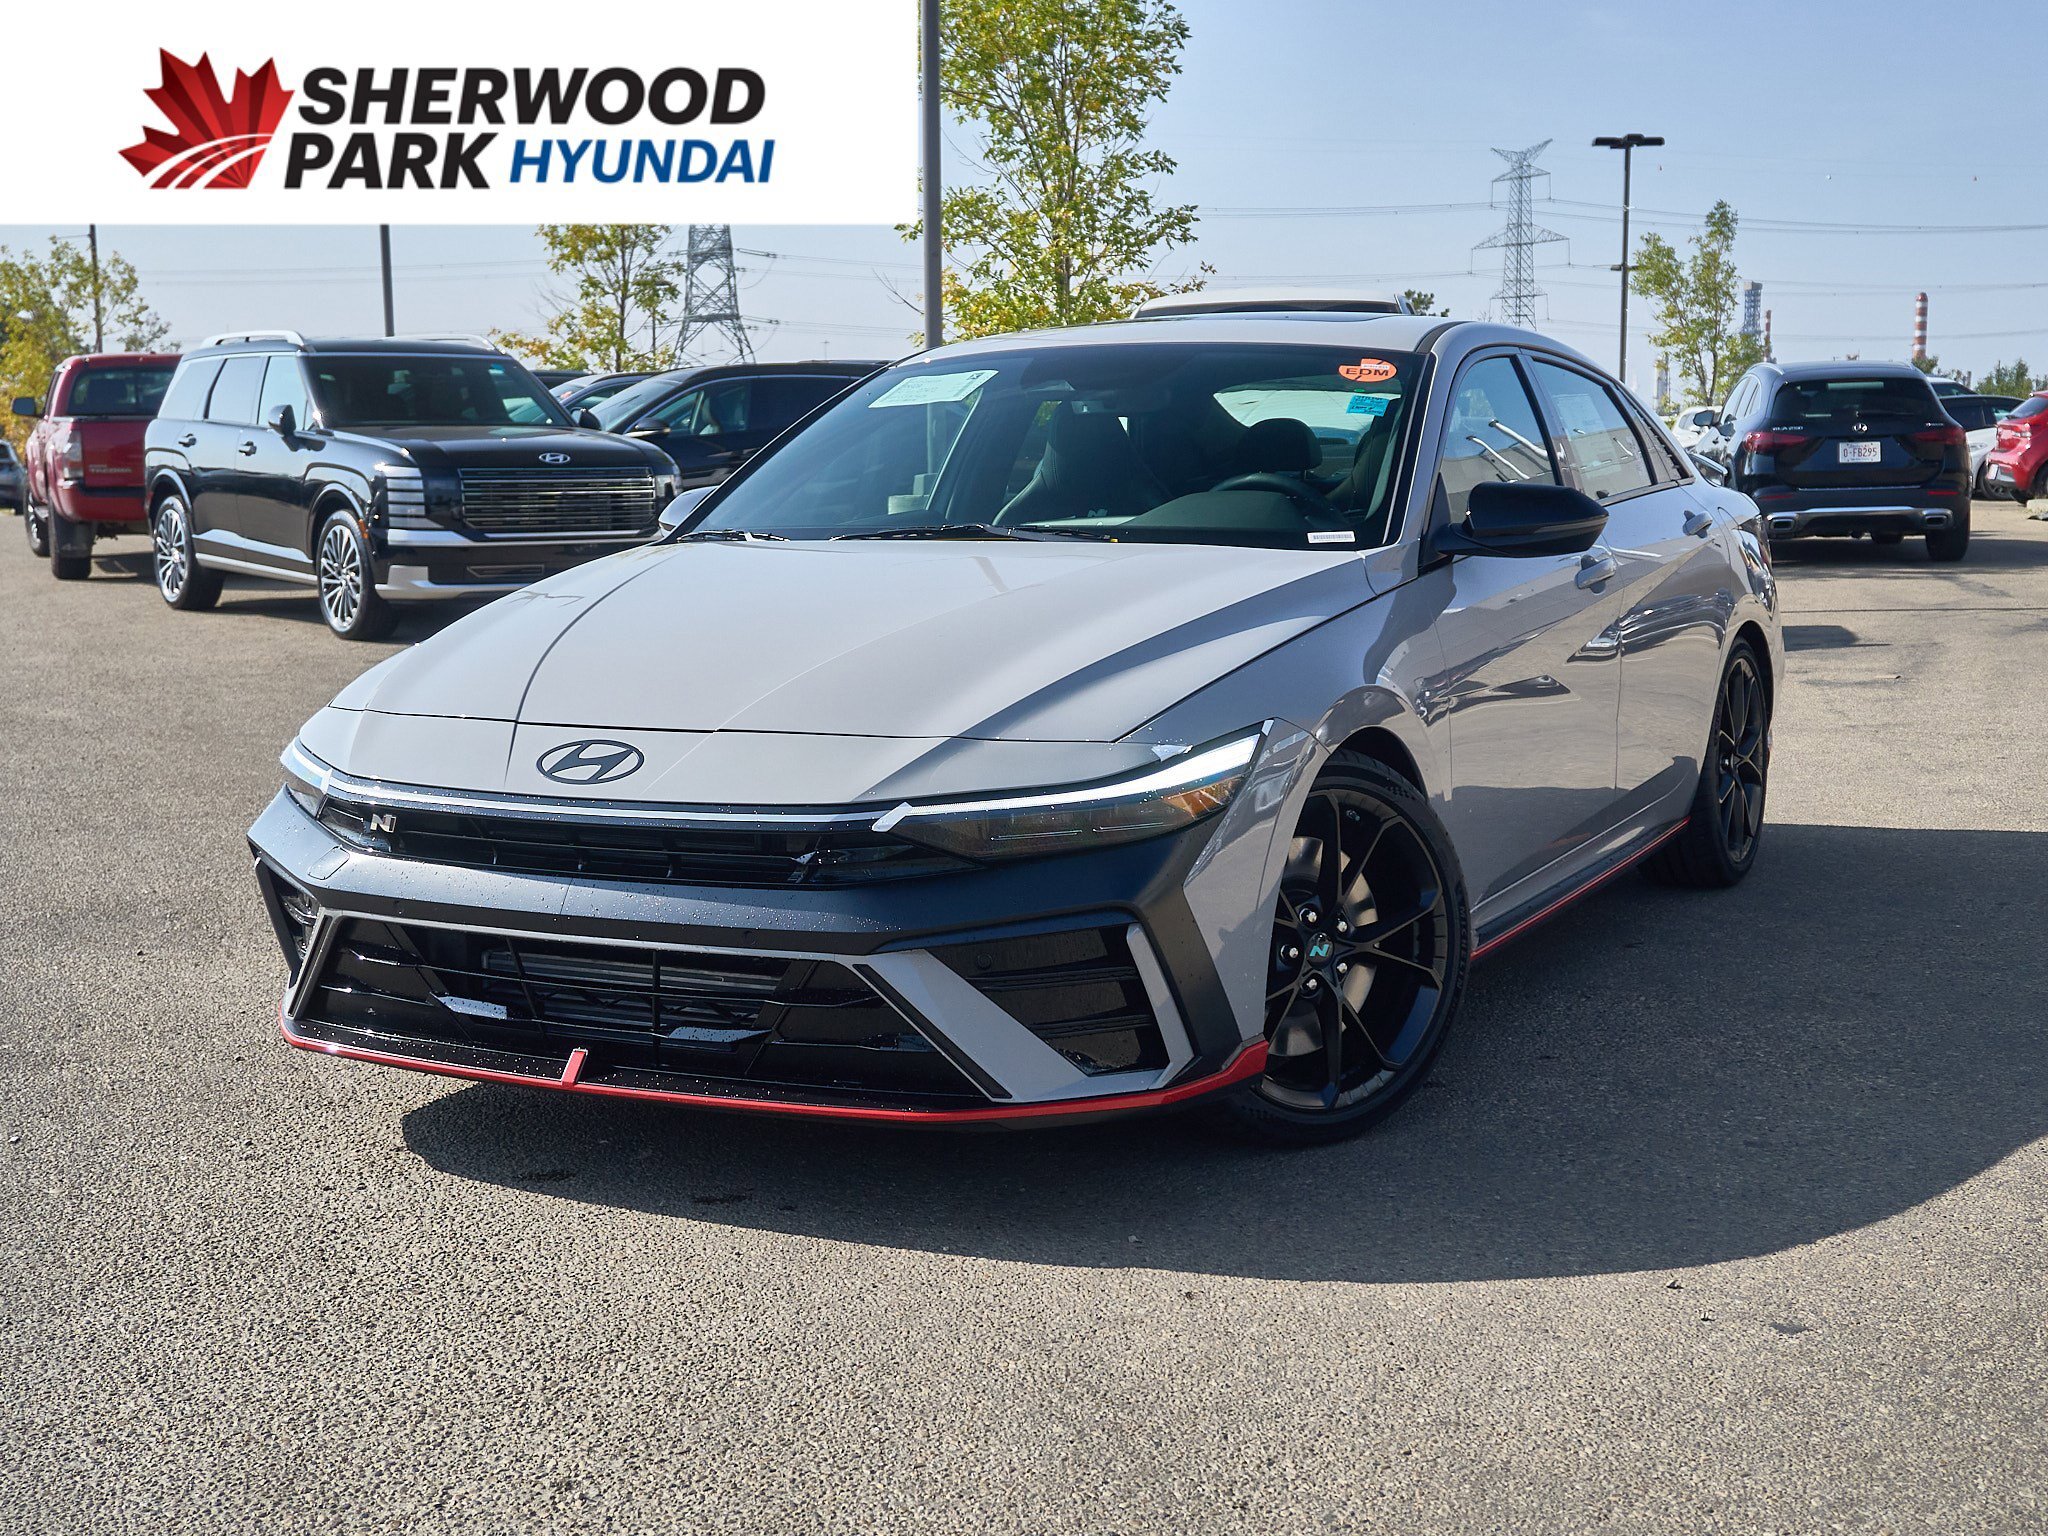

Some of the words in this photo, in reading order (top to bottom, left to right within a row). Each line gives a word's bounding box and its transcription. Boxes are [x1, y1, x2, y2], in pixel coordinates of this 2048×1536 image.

[1345, 367, 1389, 377] EDM
[370, 813, 397, 833] N
[1309, 943, 1330, 957] N
